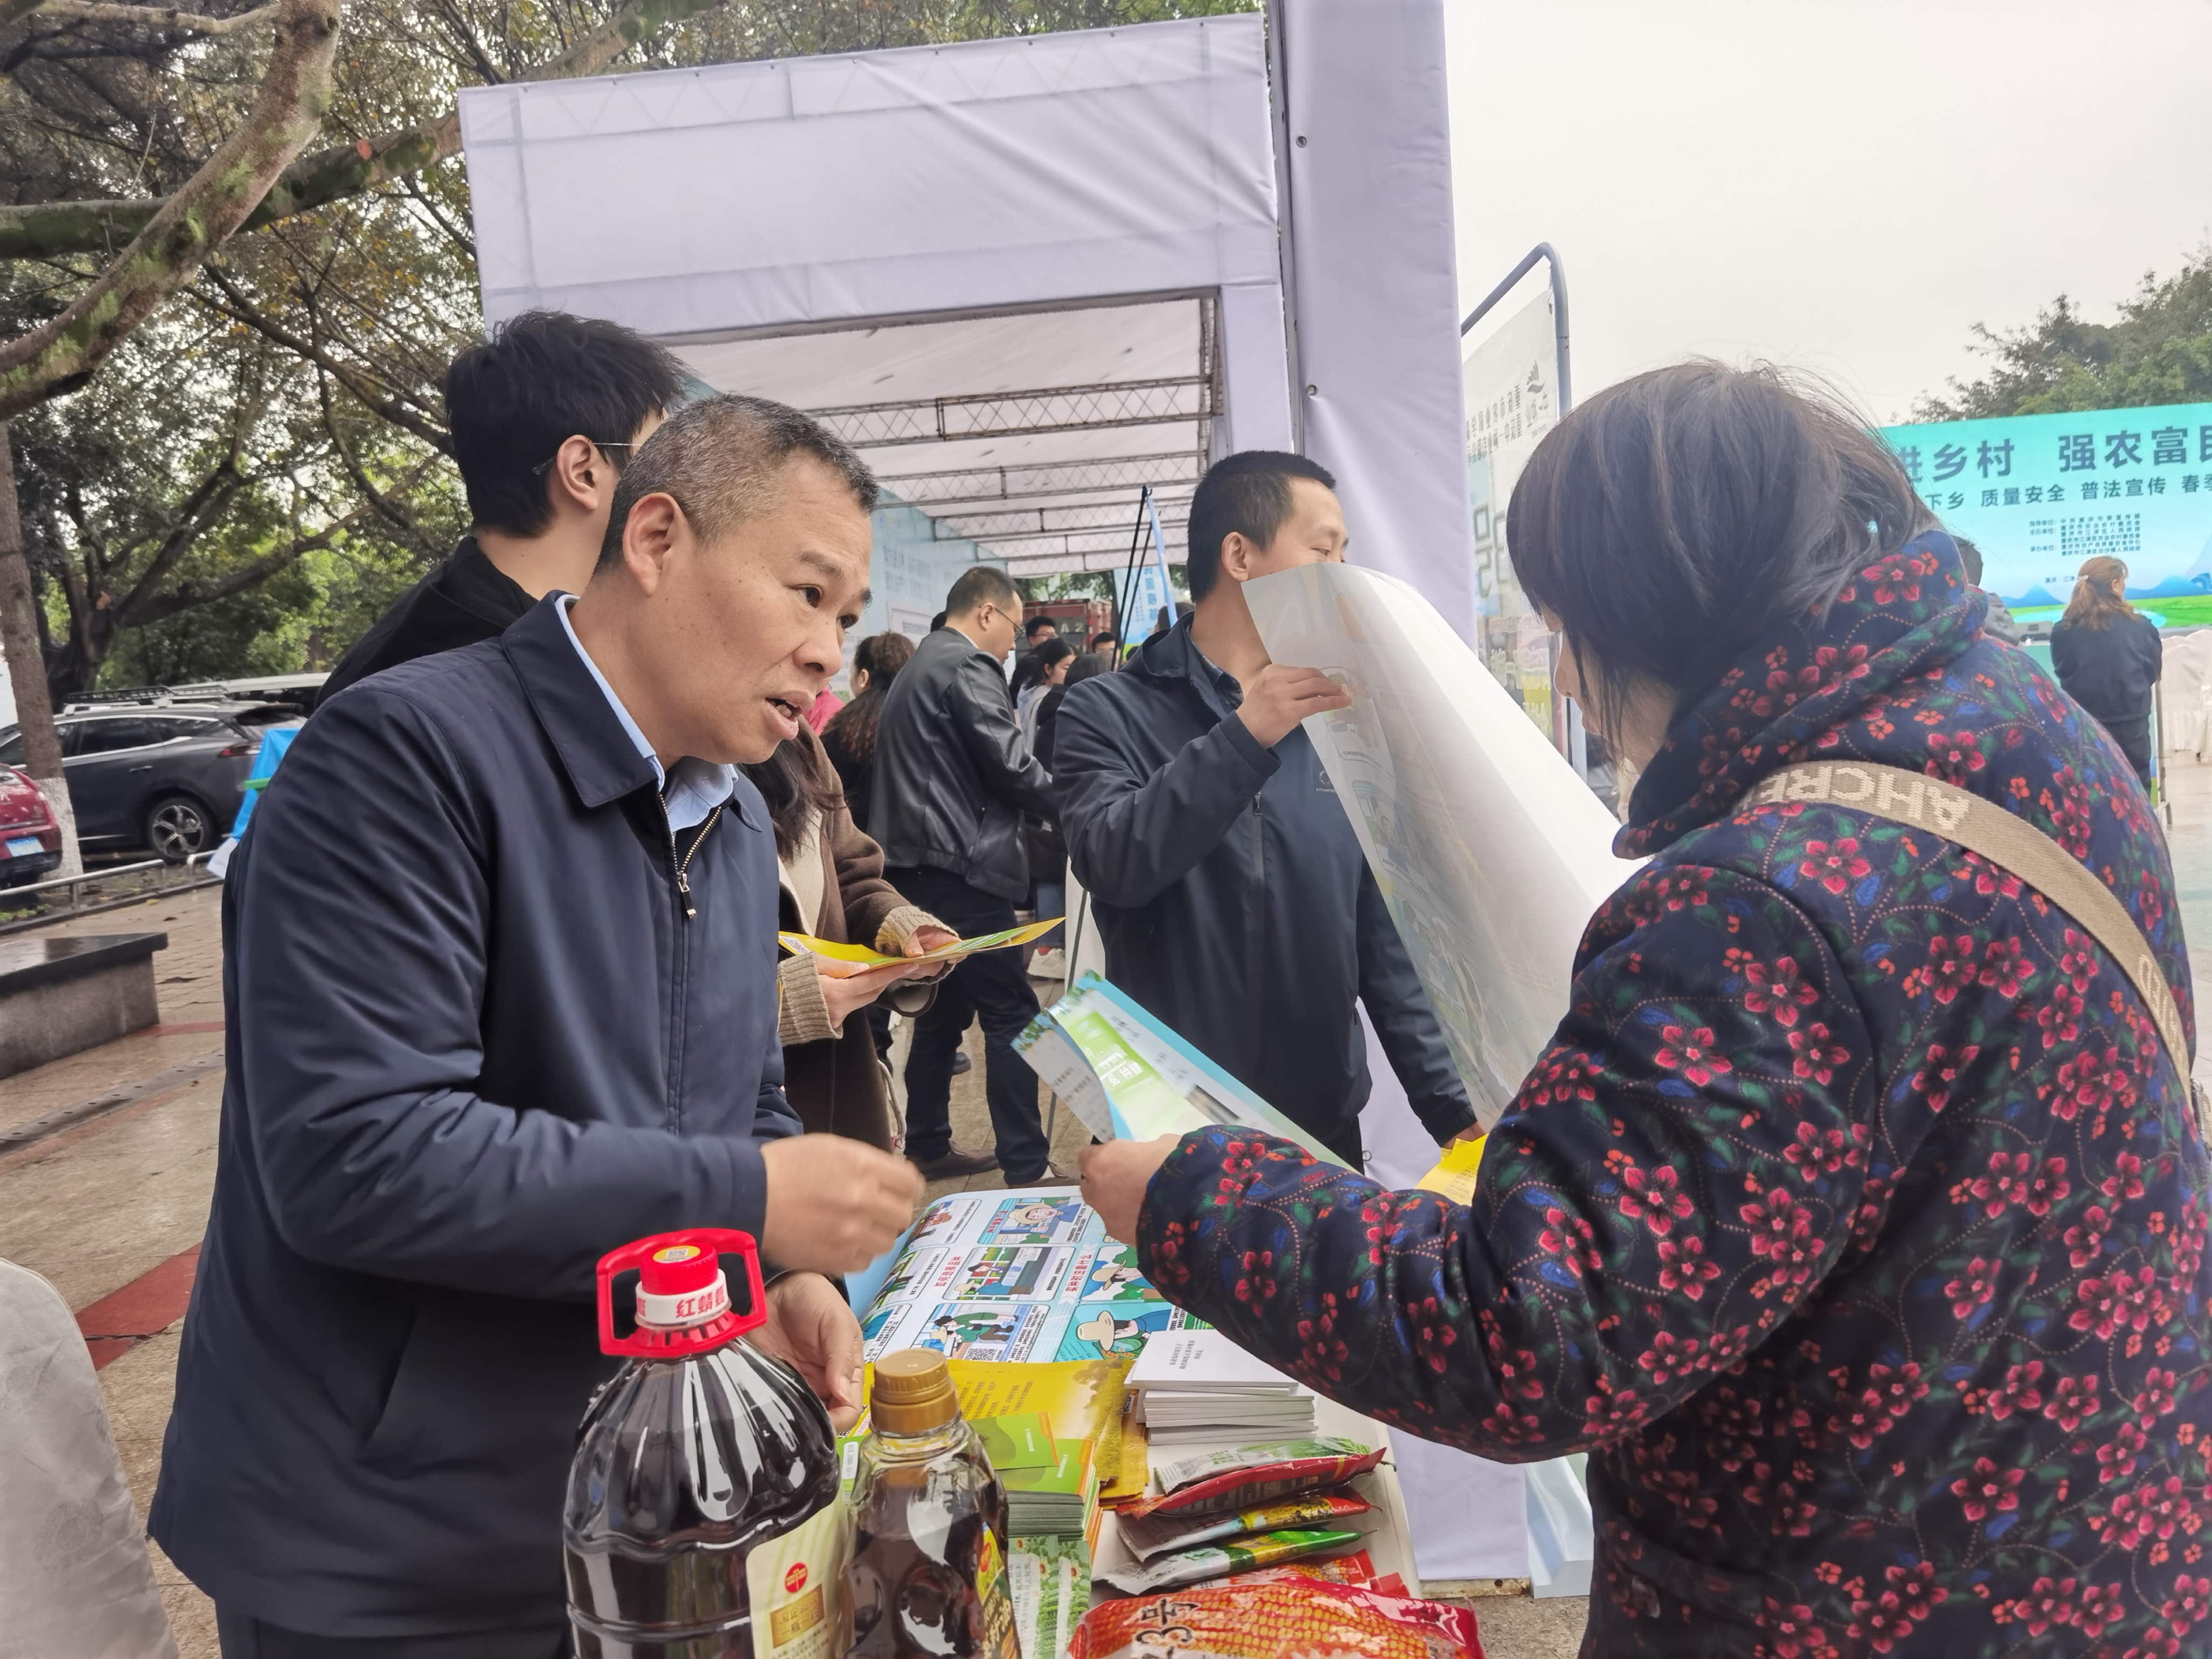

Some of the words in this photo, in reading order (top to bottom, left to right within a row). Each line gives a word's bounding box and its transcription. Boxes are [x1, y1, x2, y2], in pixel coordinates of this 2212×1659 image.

[1981, 483, 2065, 507] 质量安全
[2080, 476, 2166, 501] 普法宣传
[933, 1256, 963, 1286] 如何选择品种
[1065, 1255, 1092, 1292] 买种时注意什么
